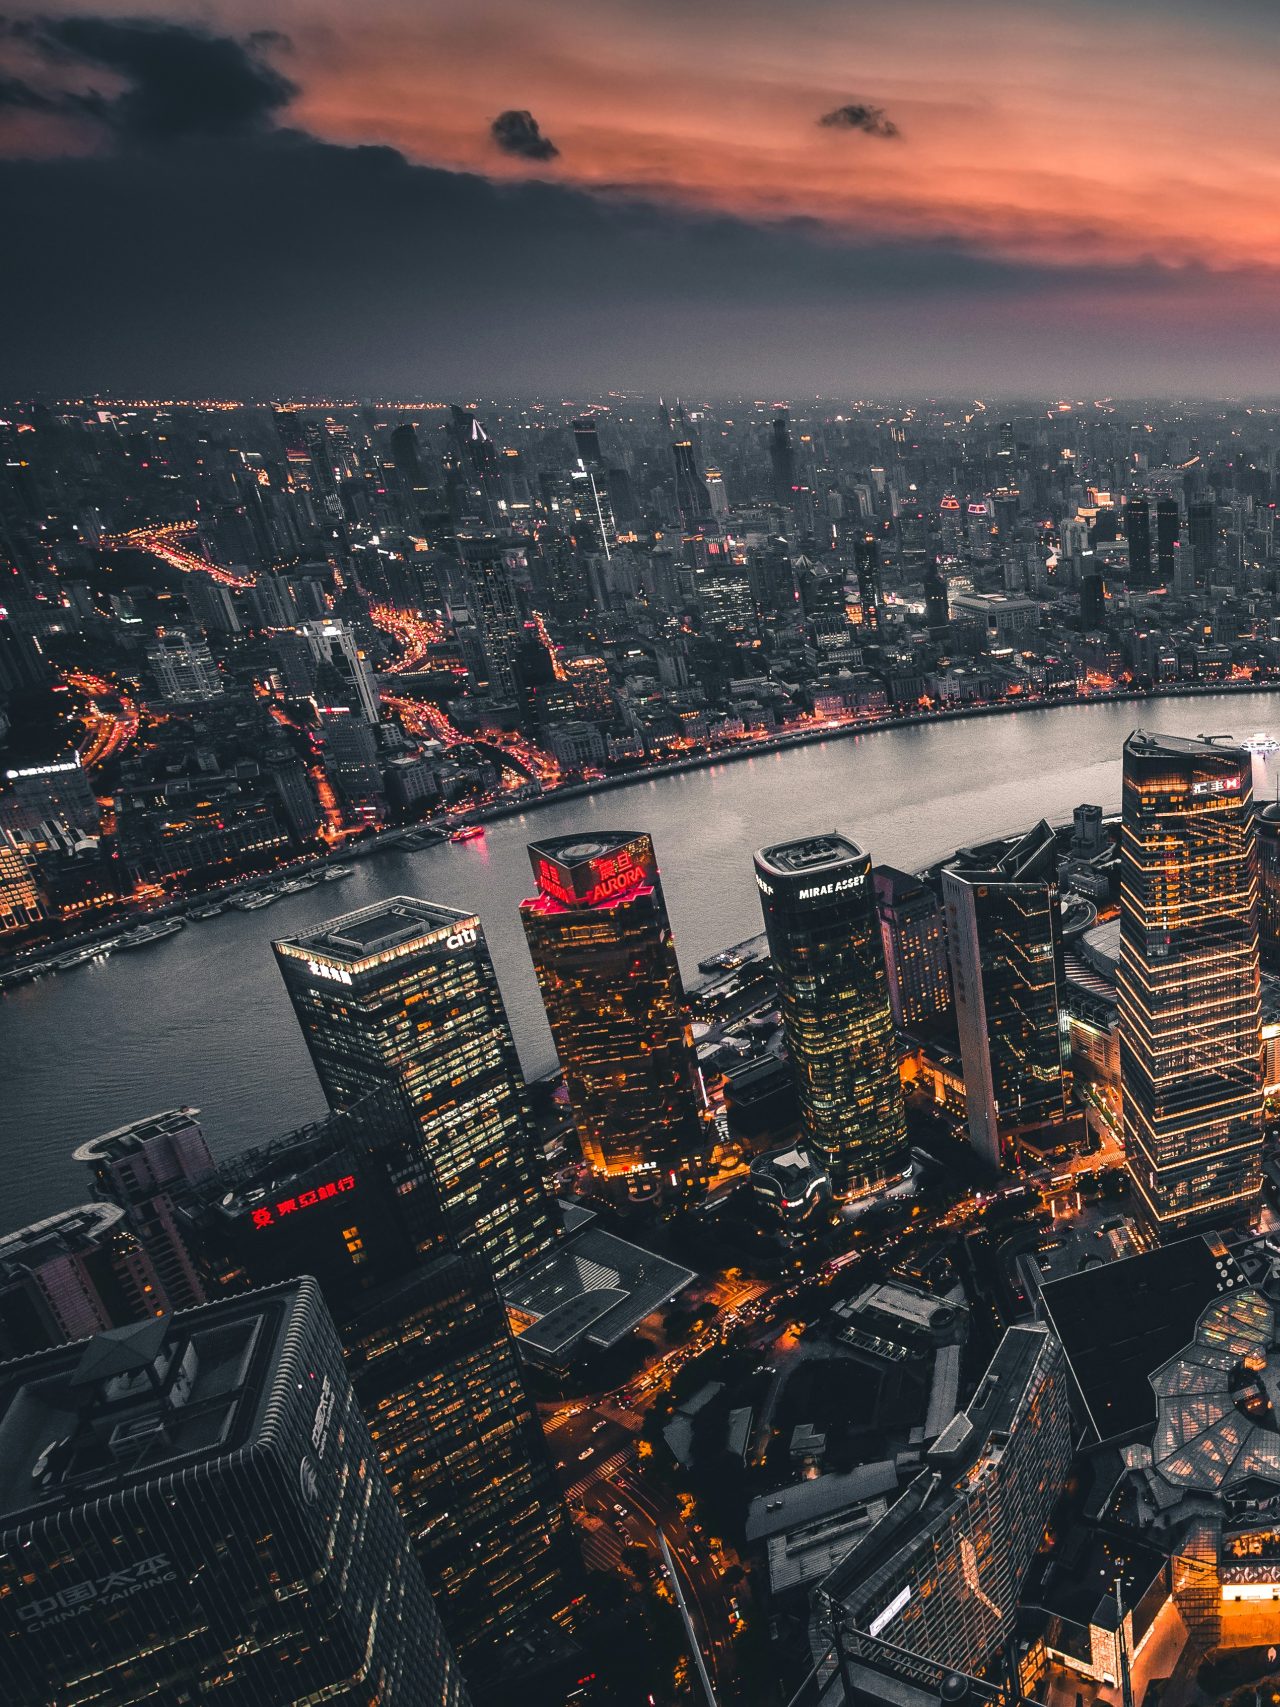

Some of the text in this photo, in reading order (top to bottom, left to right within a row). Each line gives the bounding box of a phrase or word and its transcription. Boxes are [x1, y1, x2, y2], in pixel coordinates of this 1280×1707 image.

[1193, 781, 1224, 795] 汇丰
[594, 866, 646, 900] AURORA
[799, 875, 865, 900] MIRAE ASSET
[16, 1552, 171, 1621] 中国太平
[27, 1571, 177, 1633] CHINA TAIPING
